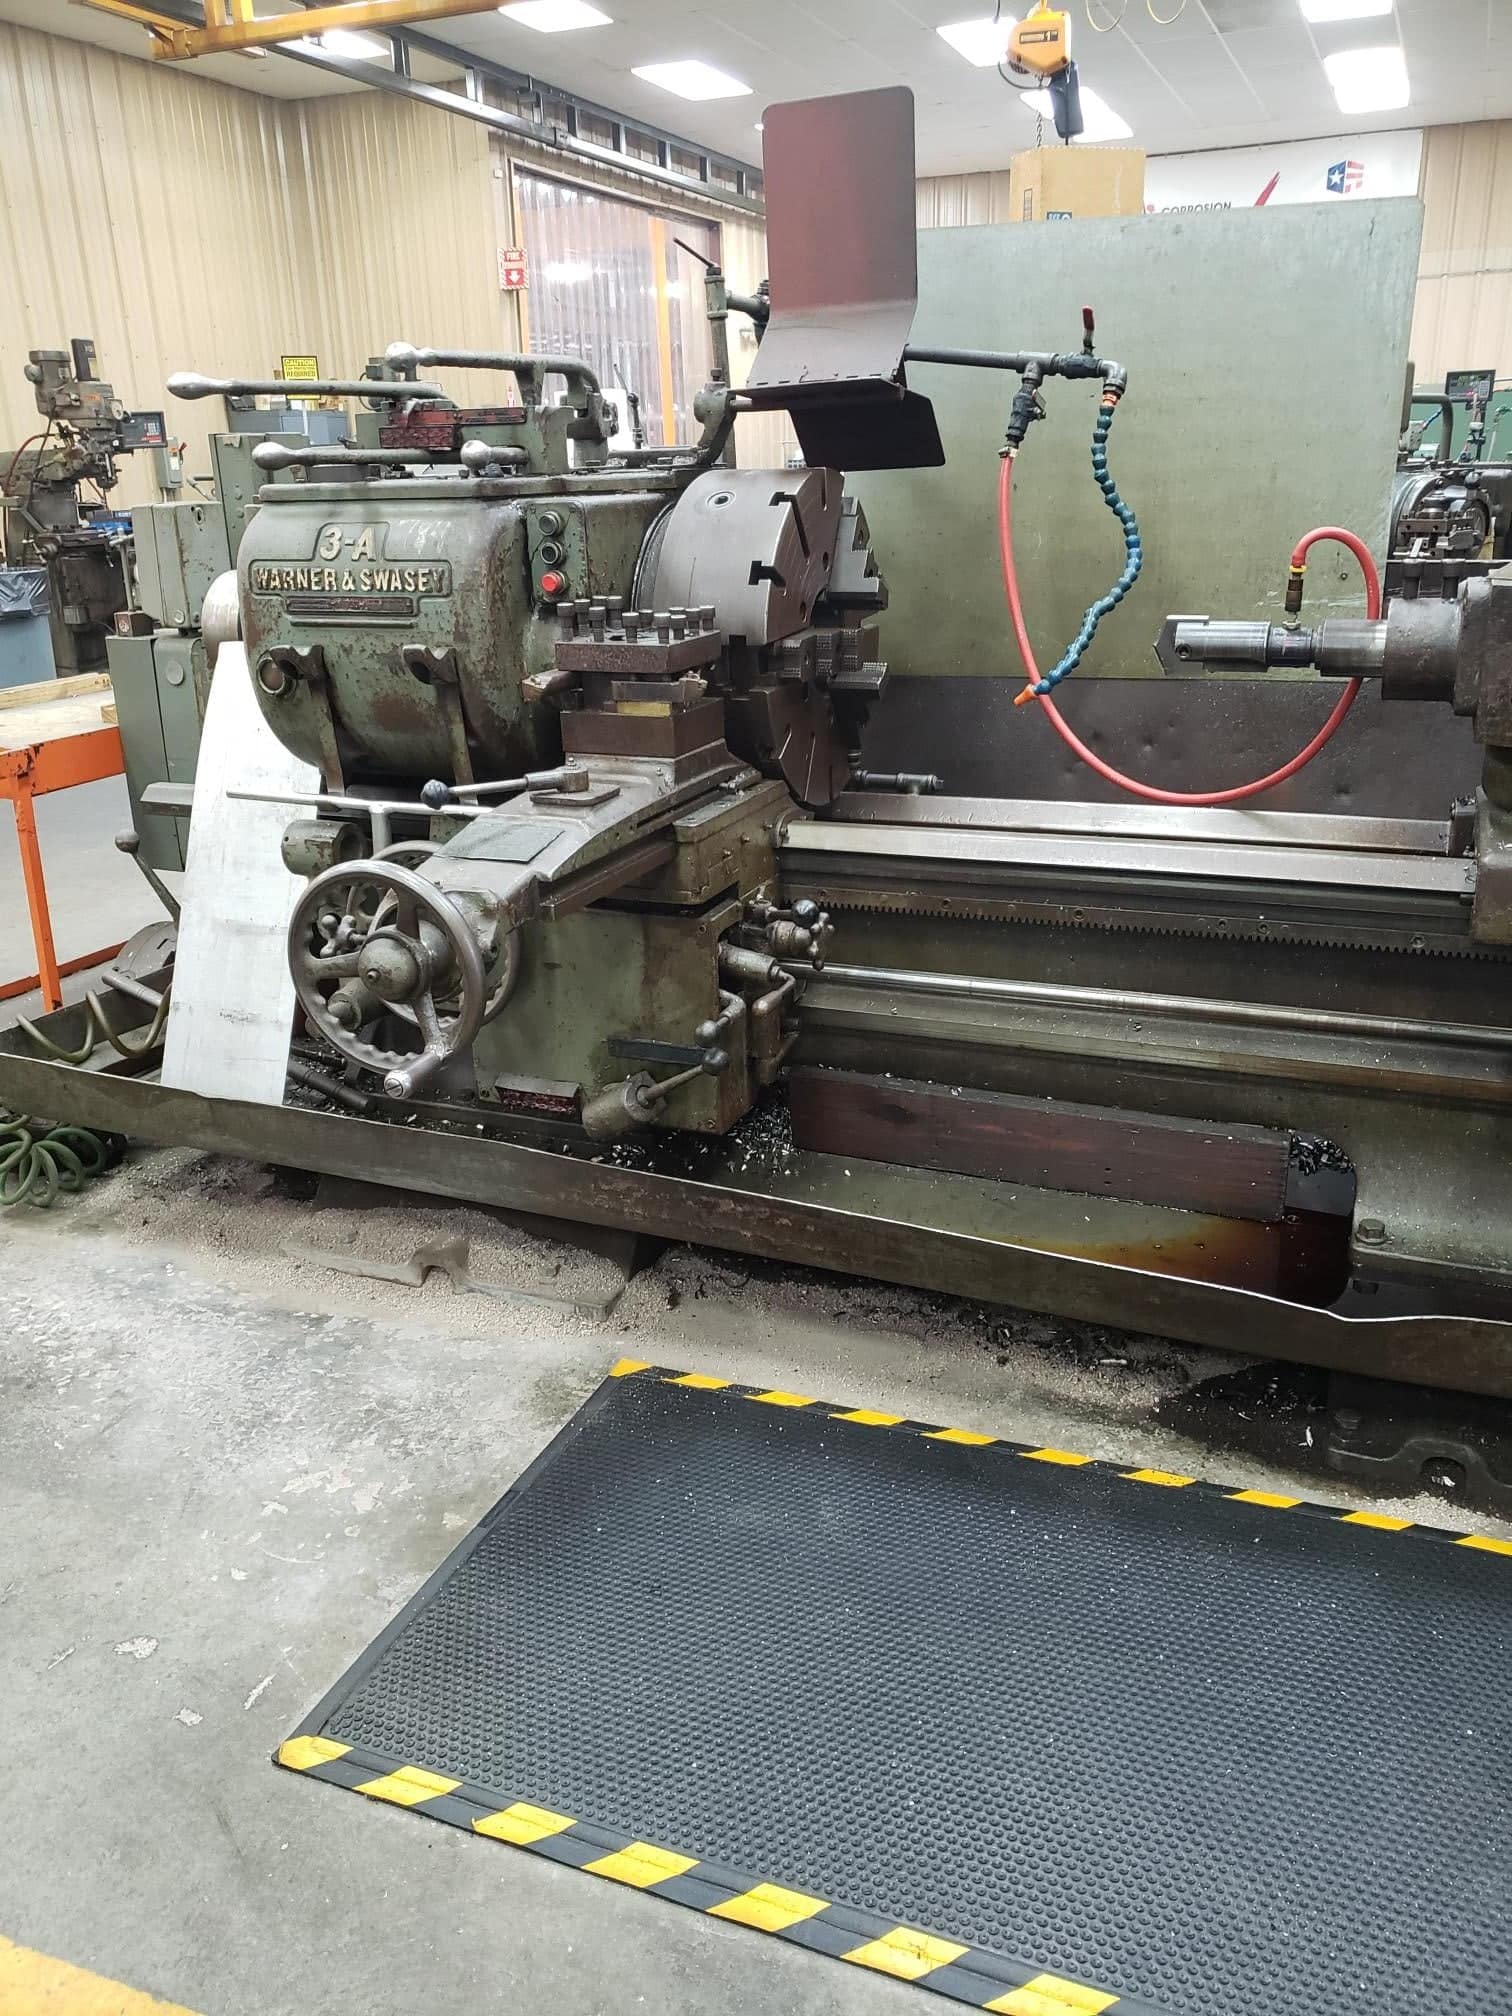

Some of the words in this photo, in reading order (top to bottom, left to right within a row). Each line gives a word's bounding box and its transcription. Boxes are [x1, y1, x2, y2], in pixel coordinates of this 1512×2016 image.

[319, 526, 377, 561] 3-A
[256, 567, 337, 592] WARNER
[341, 568, 356, 591] &
[359, 567, 445, 593] SWASEY
